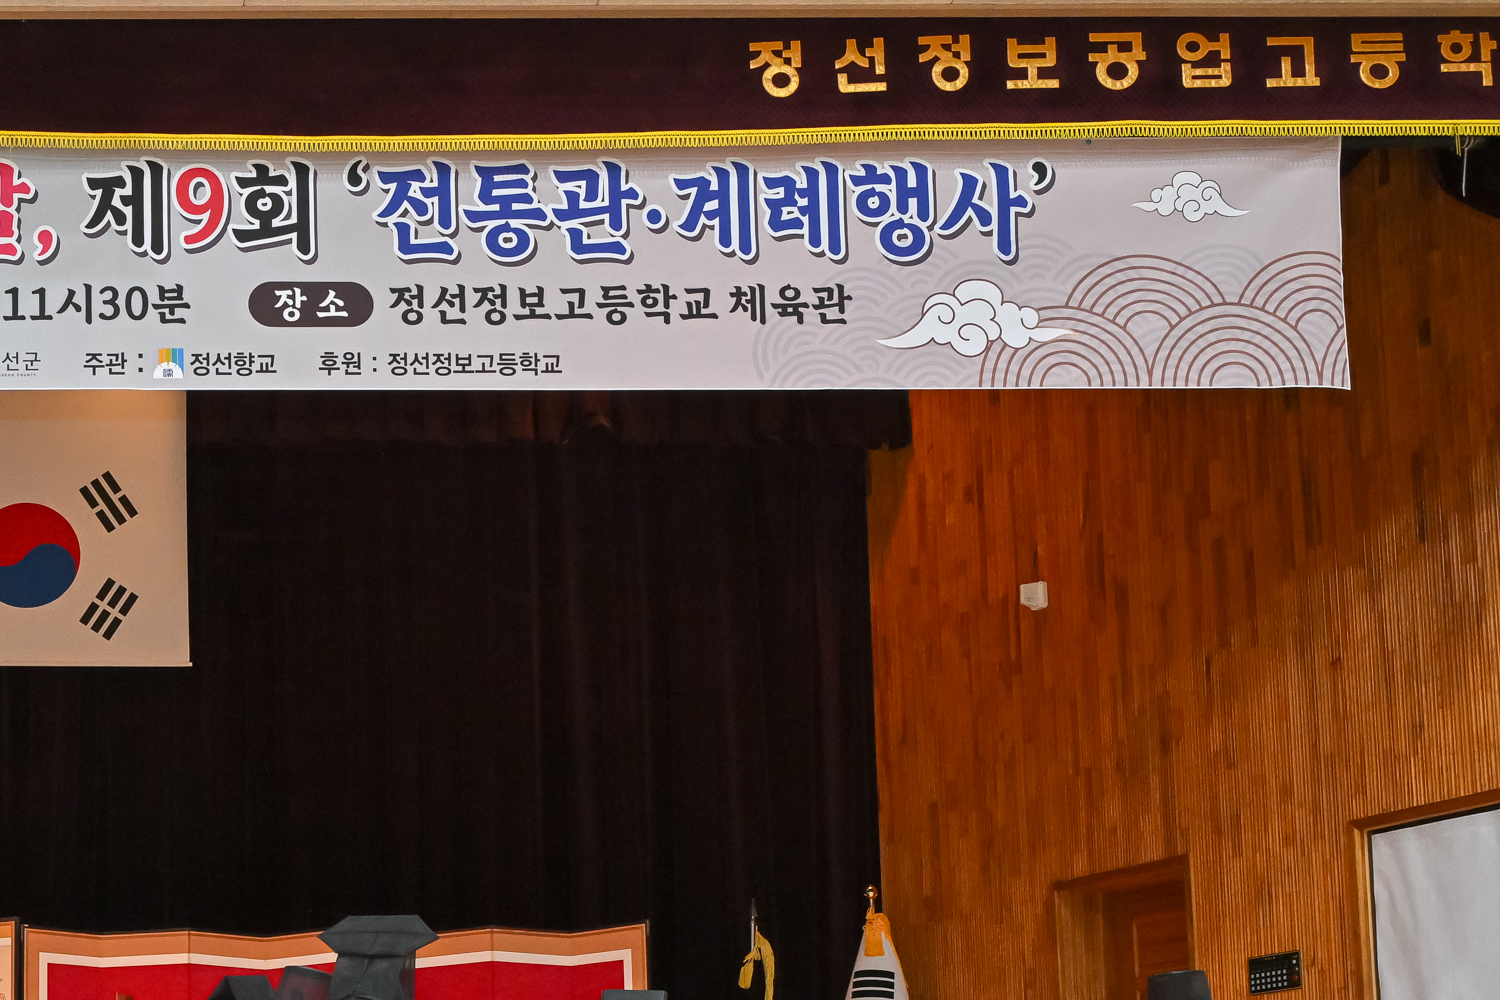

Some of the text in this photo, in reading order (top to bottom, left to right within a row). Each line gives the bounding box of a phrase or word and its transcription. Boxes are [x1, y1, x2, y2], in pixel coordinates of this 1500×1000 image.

[83, 159, 312, 258] 제9회
[1, 282, 192, 326] 11시30분
[388, 282, 719, 327] 정선정보고등학교
[728, 282, 853, 326] 체육관
[83, 351, 128, 376] 주관
[189, 351, 278, 377] 정선향교
[318, 351, 362, 376] 후원
[387, 351, 563, 377] 정선정보고등학교
